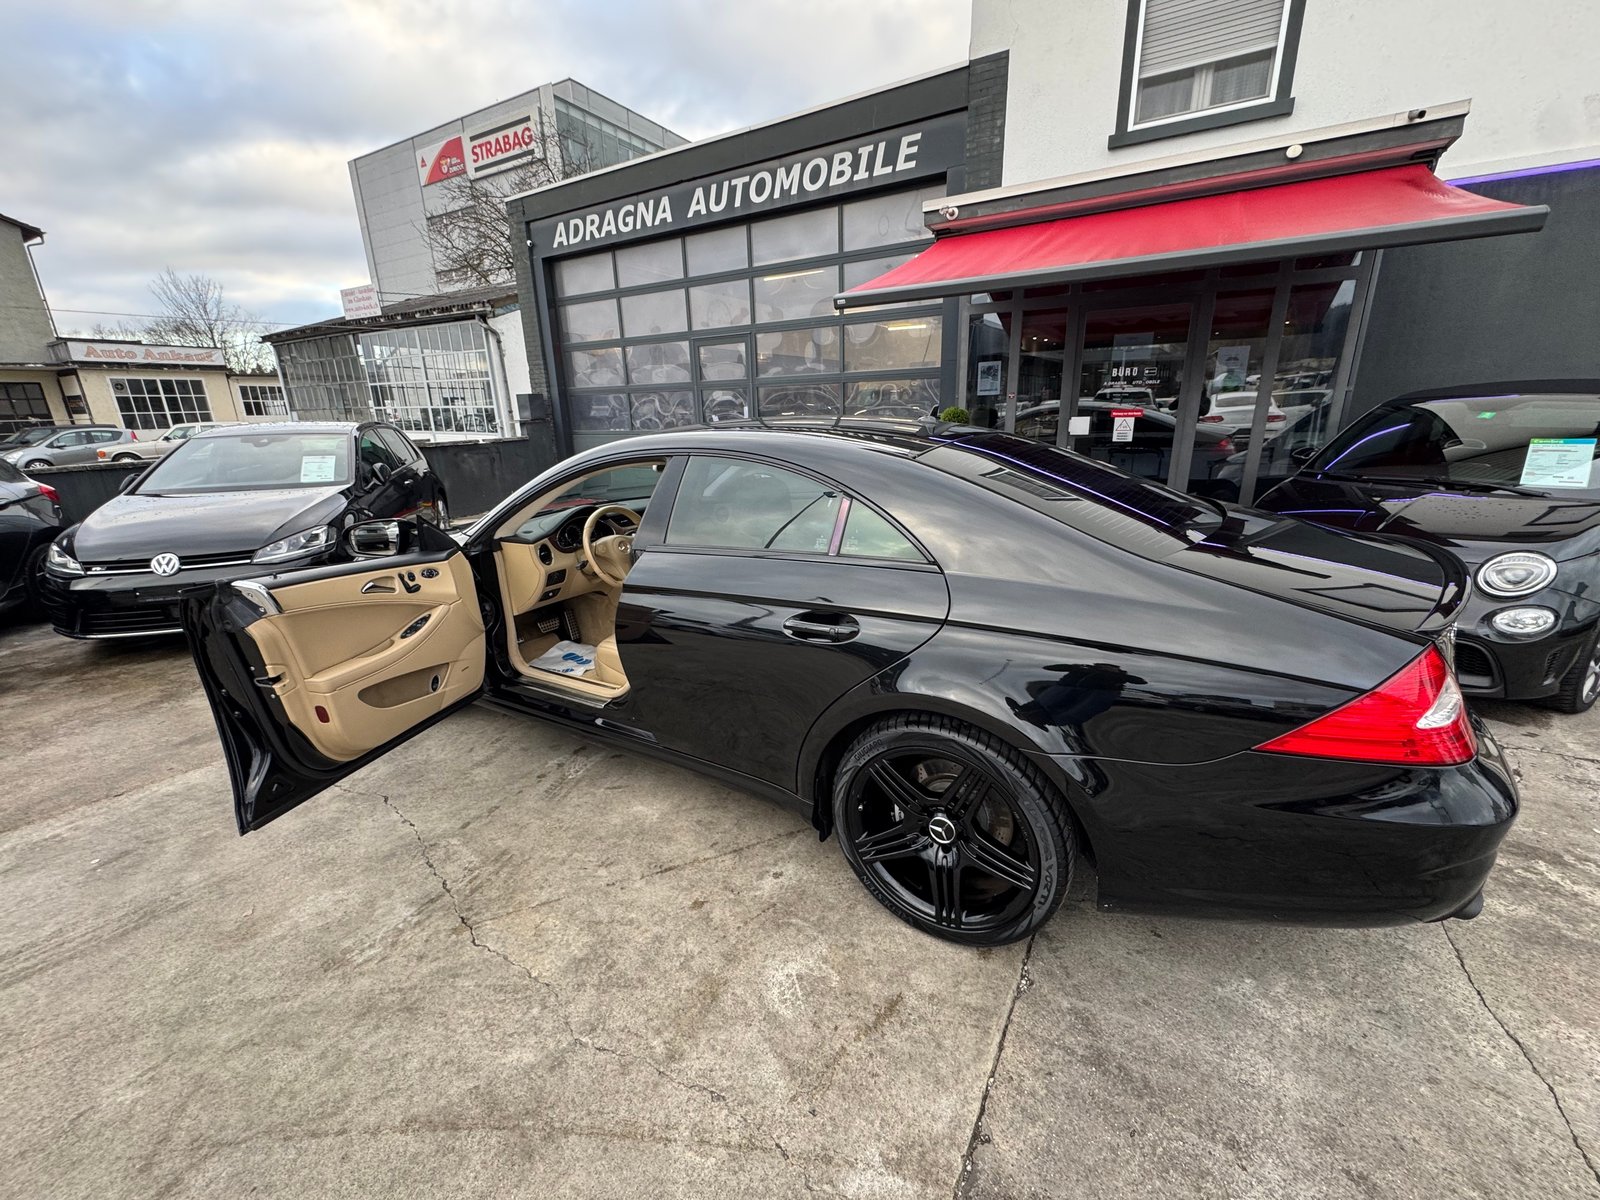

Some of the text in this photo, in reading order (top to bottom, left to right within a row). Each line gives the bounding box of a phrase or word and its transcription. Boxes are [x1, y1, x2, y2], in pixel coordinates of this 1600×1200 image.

[471, 126, 534, 163] STRABAG
[553, 131, 922, 248] ADRAGNA AUTOMOBILE
[84, 344, 216, 363] Auto Ankauf
